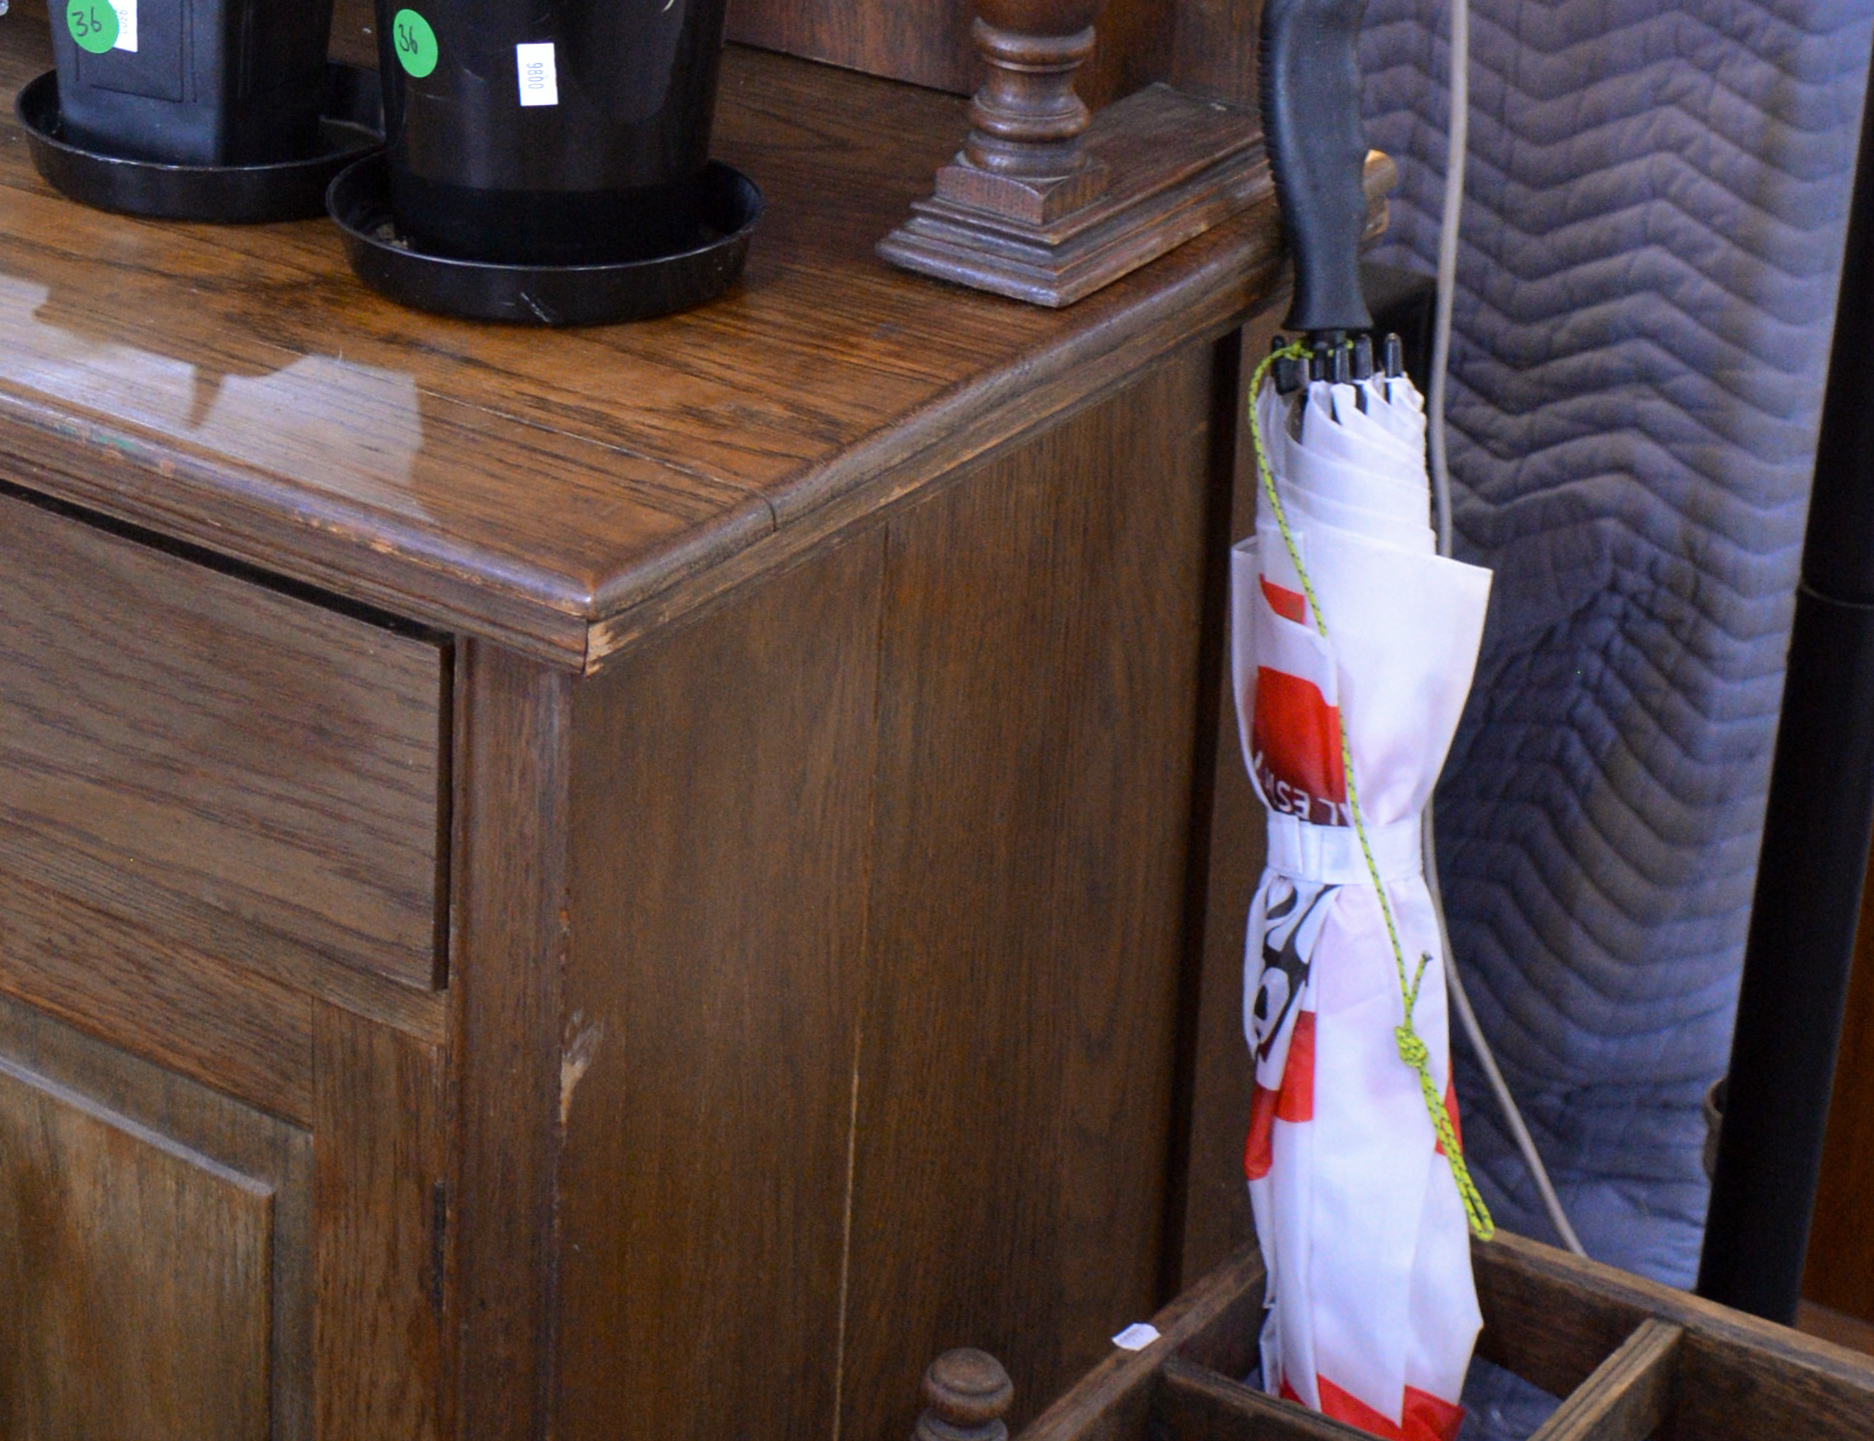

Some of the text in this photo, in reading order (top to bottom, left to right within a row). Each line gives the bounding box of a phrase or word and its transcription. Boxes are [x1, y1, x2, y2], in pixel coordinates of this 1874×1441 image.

[71, 6, 102, 37] 36
[398, 23, 419, 55] 36
[526, 62, 545, 90] 9800
